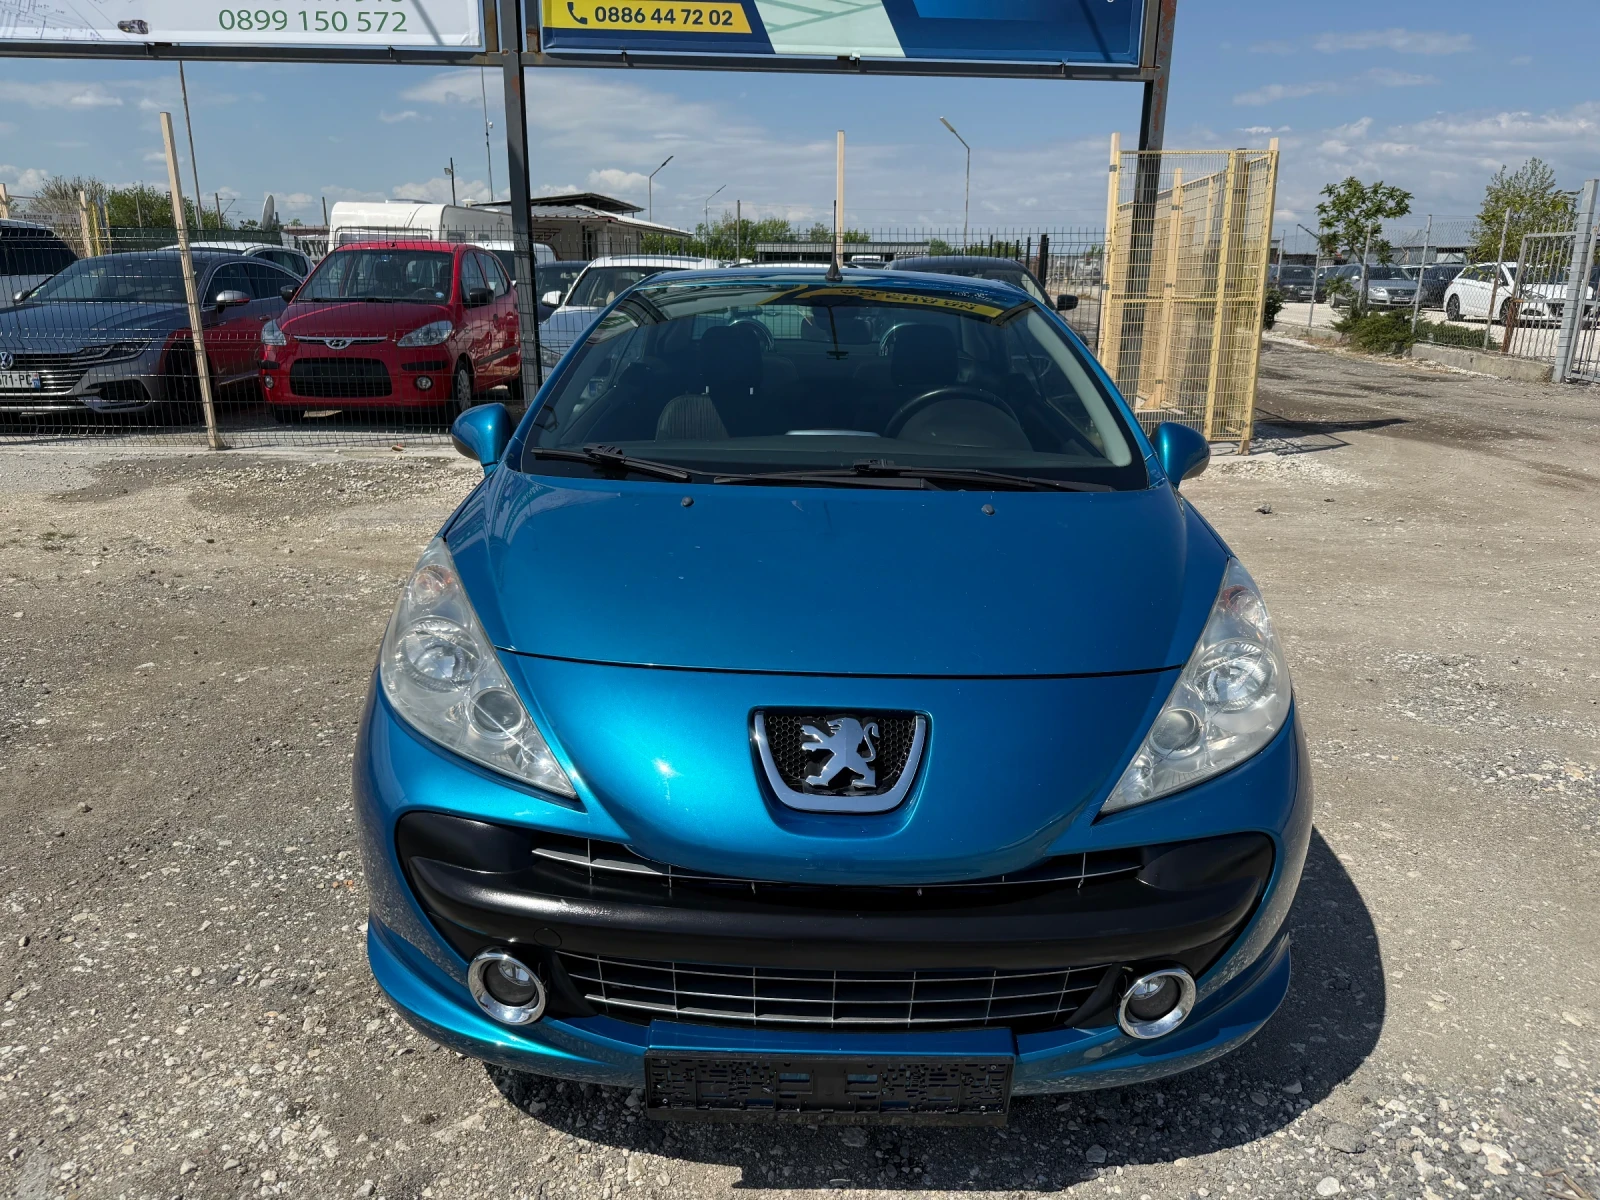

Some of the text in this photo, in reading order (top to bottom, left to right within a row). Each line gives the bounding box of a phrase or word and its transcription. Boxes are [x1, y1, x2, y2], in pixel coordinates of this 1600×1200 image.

[218, 9, 408, 32] 0899 150 572
[594, 6, 733, 26] 0886 44 72 02
